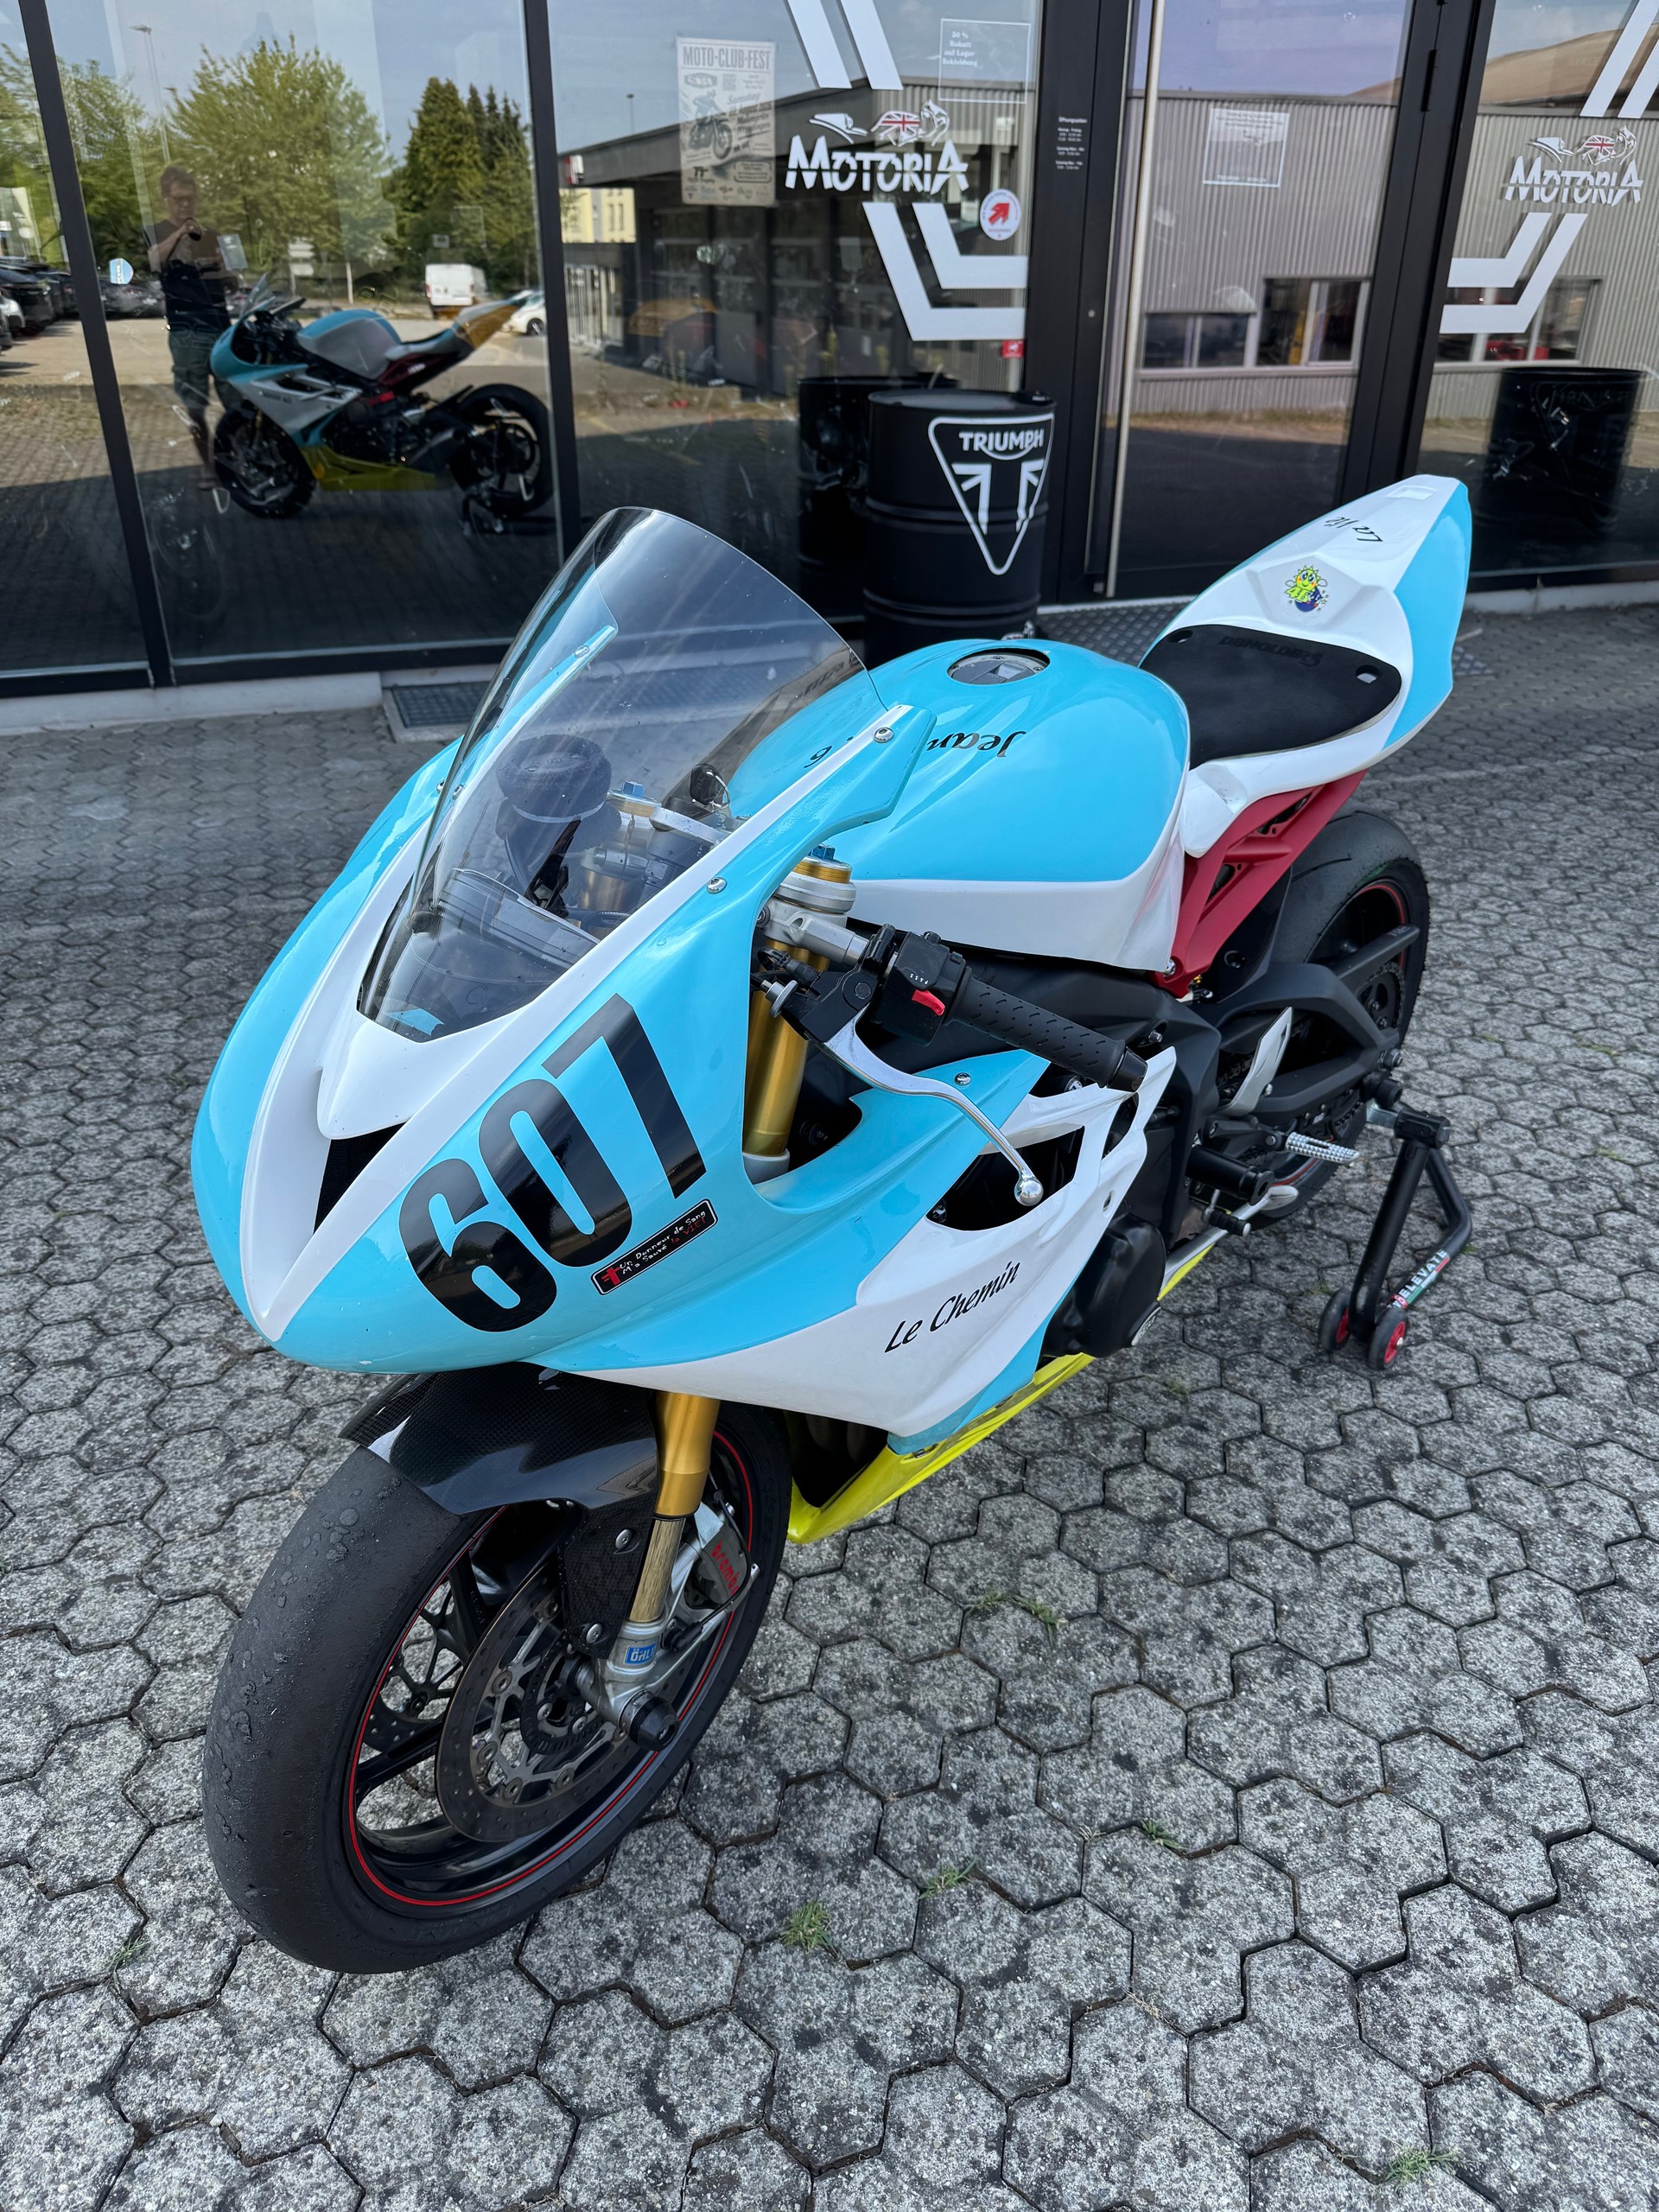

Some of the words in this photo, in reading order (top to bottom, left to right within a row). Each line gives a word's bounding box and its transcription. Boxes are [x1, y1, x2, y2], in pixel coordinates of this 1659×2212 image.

[958, 429, 1045, 458] TRIUMPH
[1352, 526, 1383, 542] La
[1285, 587, 1309, 603] 46
[926, 731, 1027, 758] Jean
[909, 973, 929, 985] PASS
[398, 993, 707, 1332] 607
[635, 1235, 671, 1260] Donneur
[674, 1225, 684, 1235] de
[685, 1211, 706, 1226] Sang
[642, 1244, 668, 1262] Sauvé
[1398, 1249, 1448, 1299] ELEVATE
[884, 1319, 924, 1353] Le
[929, 1260, 1021, 1332] Chemin
